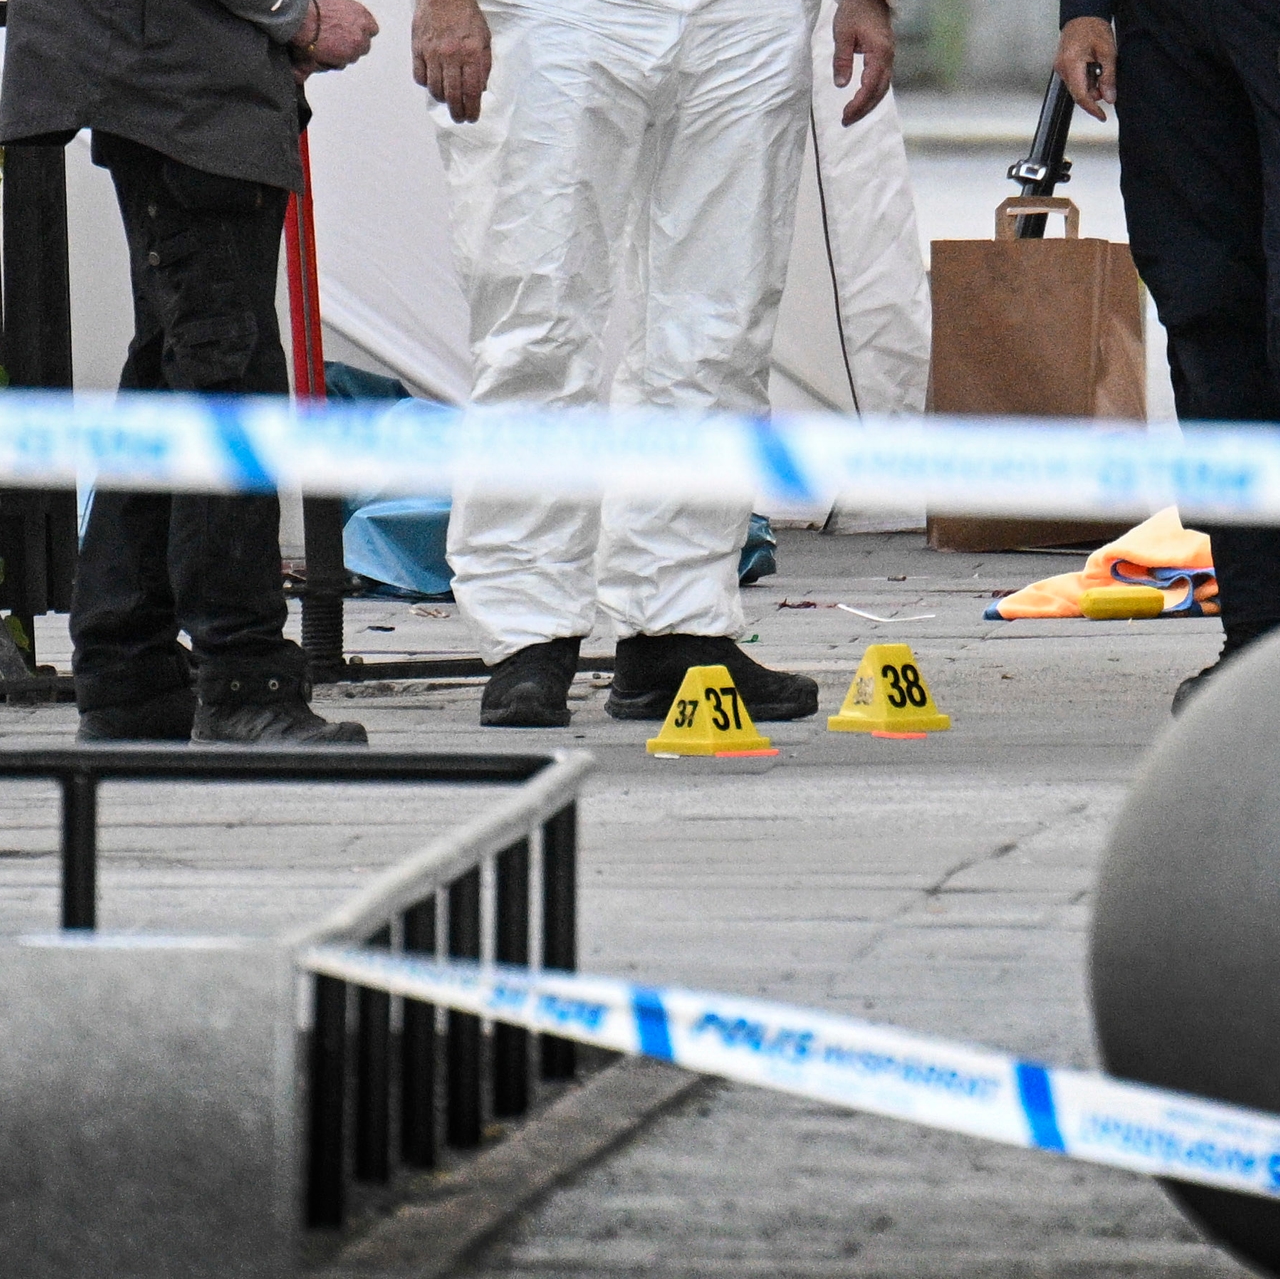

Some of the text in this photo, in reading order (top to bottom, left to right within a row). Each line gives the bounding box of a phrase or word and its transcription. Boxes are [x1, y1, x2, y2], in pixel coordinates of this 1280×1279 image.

[881, 664, 928, 709] 38
[674, 687, 742, 731] 37 37
